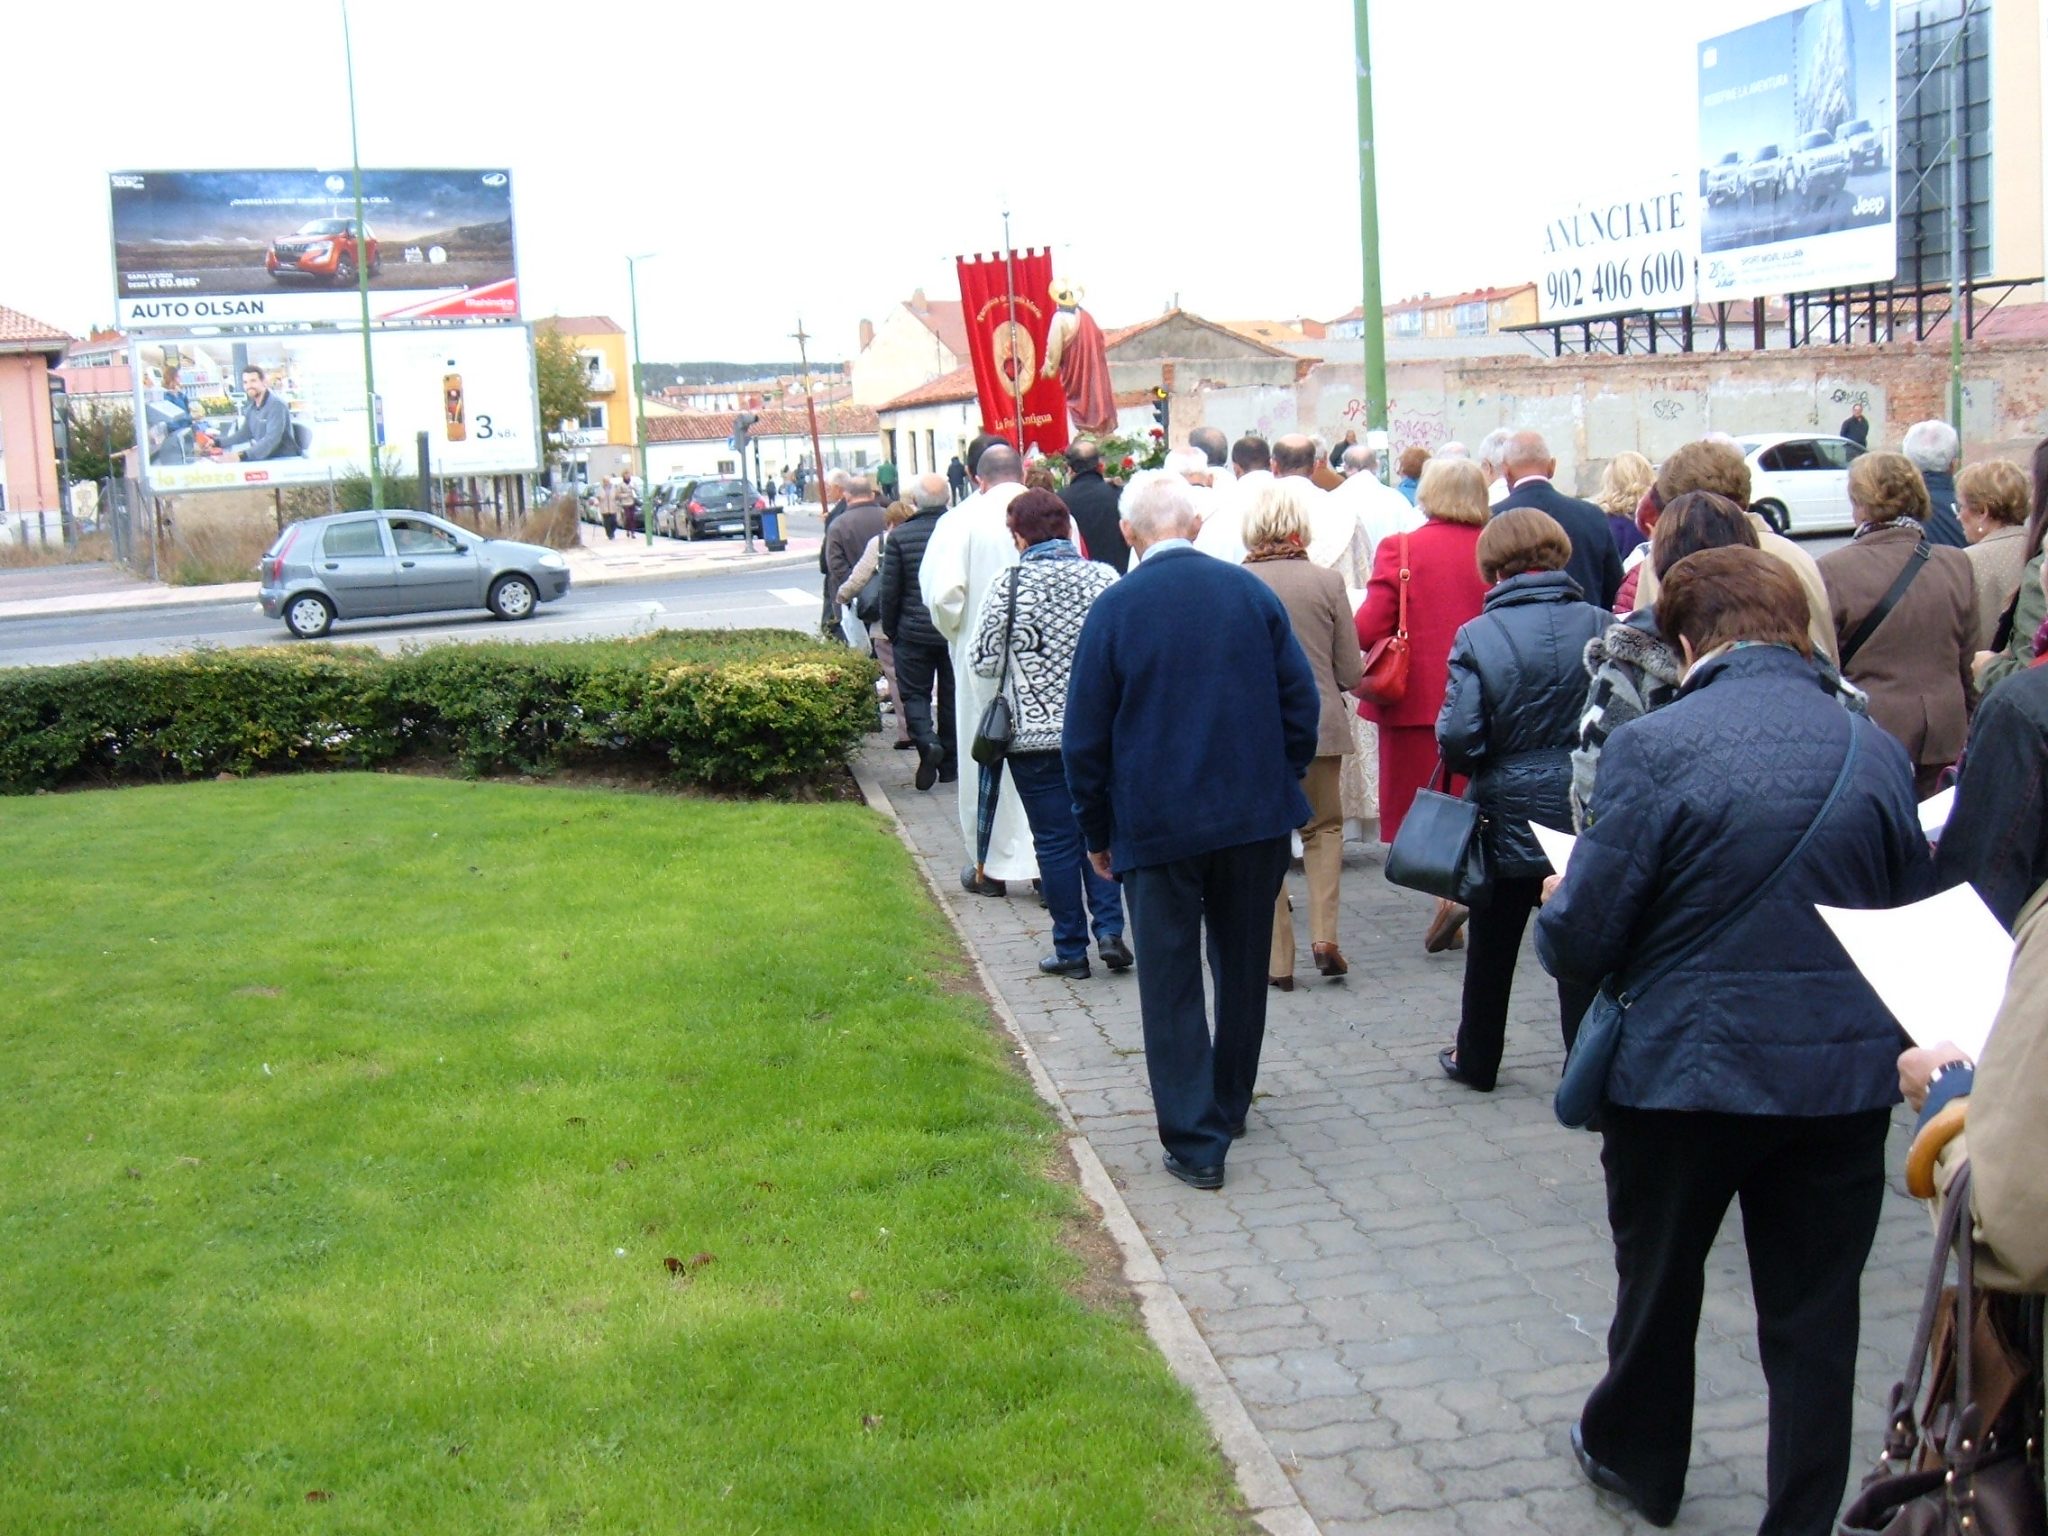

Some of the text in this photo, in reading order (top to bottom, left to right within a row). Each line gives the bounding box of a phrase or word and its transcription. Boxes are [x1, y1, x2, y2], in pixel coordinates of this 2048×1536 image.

[1543, 191, 1686, 254] ANÚNCIATE
[1852, 195, 1886, 217] Jeep
[1547, 249, 1684, 309] 902 406 600
[131, 300, 265, 319] AUTO OLSAN
